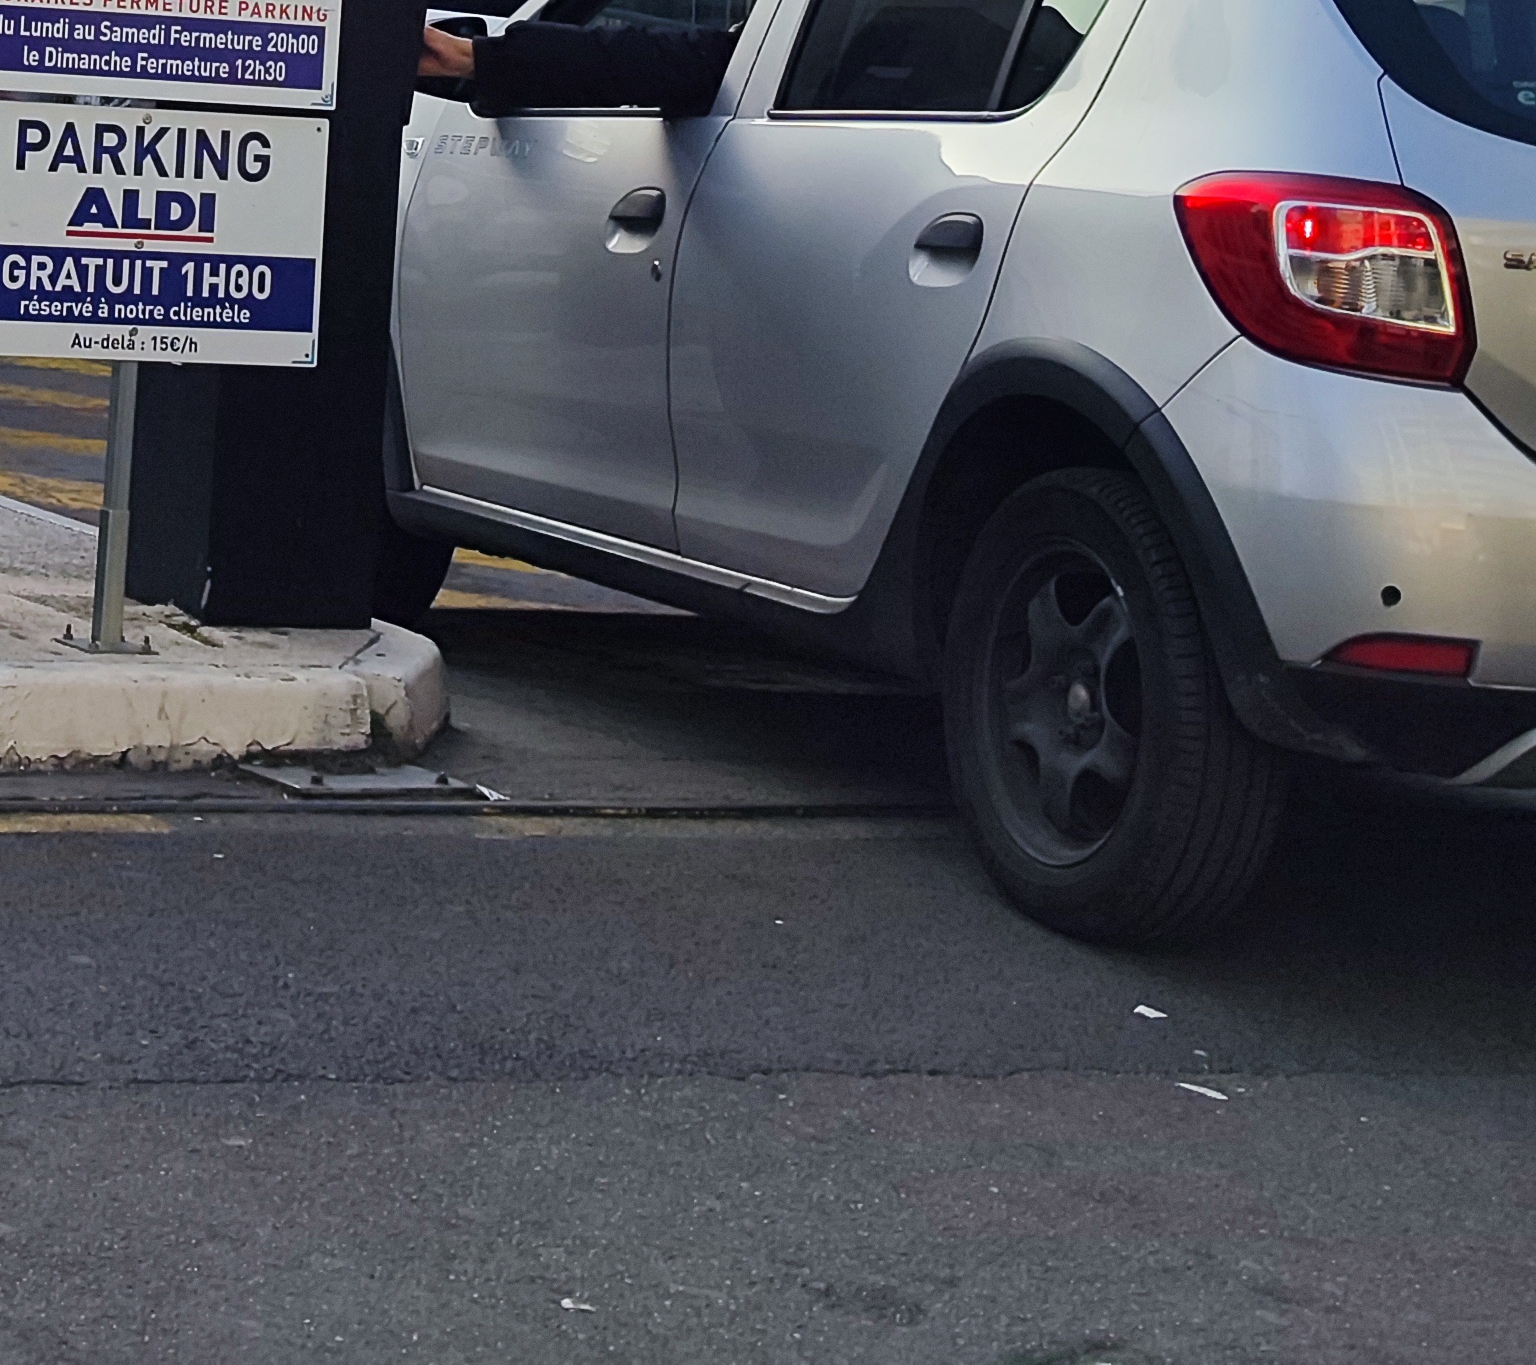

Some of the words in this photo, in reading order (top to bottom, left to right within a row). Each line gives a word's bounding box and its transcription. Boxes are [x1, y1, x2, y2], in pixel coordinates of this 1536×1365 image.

[238, 0, 328, 23] PARKING
[20, 15, 69, 39] Lundi
[74, 23, 95, 40] au
[99, 21, 165, 45] Samedi
[170, 26, 262, 51] Fermeture
[267, 32, 319, 54] 20h00
[23, 45, 39, 66] le
[44, 46, 131, 72] Dimanche
[137, 53, 229, 78] Fermeture
[235, 58, 286, 81] 12h30
[15, 119, 272, 182] PARKING
[66, 186, 217, 233] ALDI
[2, 254, 168, 296] GRATUIT
[19, 295, 93, 317] réservé
[97, 298, 109, 317] à
[114, 303, 164, 320] notre
[169, 302, 251, 323] clientèle
[150, 335, 198, 354] 15€/h
